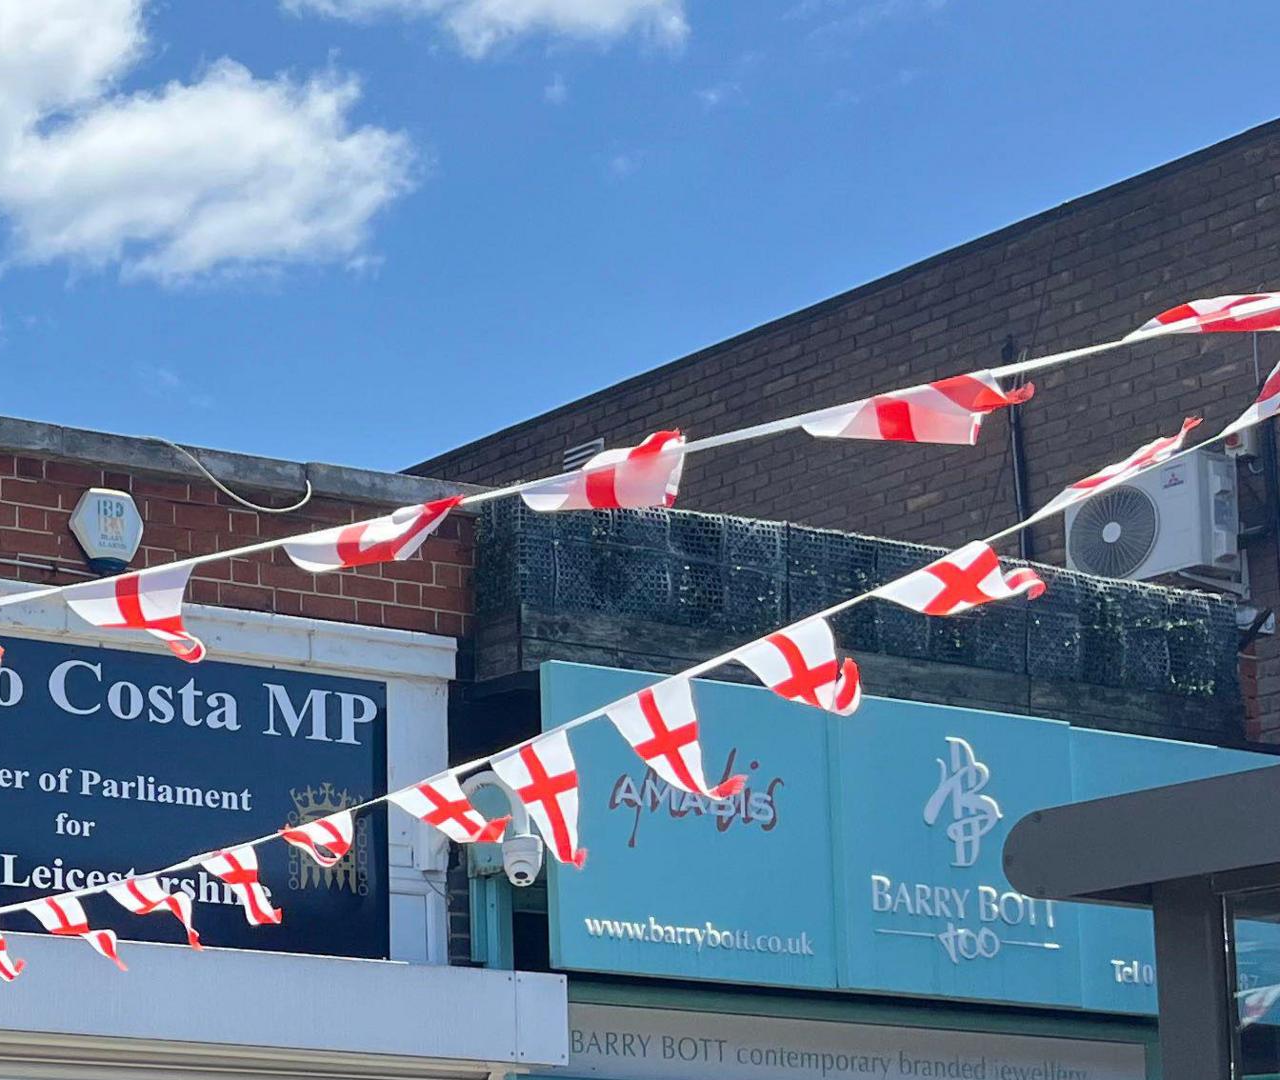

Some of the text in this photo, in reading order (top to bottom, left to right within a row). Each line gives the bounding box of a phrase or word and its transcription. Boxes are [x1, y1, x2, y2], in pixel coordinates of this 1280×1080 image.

[48, 657, 241, 732] Costa
[261, 682, 379, 746] MP
[37, 767, 71, 794] of
[80, 771, 253, 812] Parliament
[54, 811, 97, 838] for
[871, 874, 970, 920] BARRY
[584, 915, 815, 957] www.barrybott.co.uk
[571, 1029, 652, 1060] BARRY
[661, 1036, 727, 1065] BOTT
